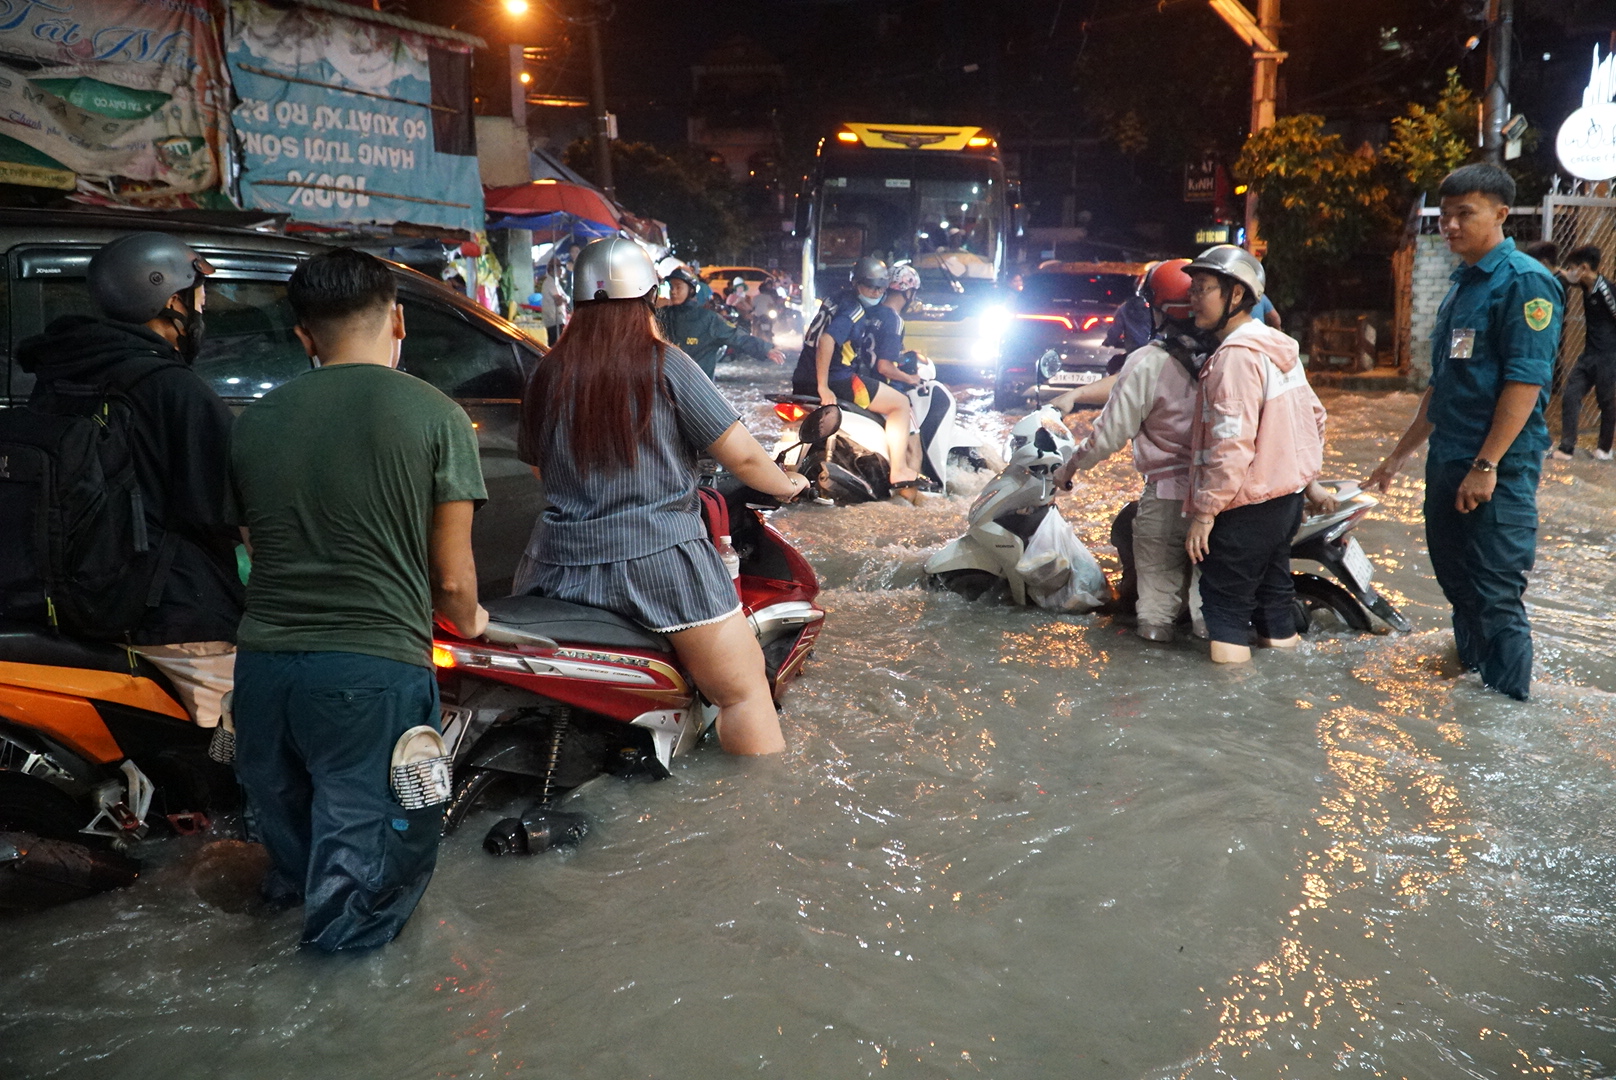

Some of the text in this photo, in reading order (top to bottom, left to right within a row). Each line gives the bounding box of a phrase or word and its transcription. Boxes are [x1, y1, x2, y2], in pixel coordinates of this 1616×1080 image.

[275, 101, 309, 129] RÕ
[313, 104, 343, 133] XỨ
[347, 109, 399, 139] XUẤT
[403, 118, 427, 144] CÓ
[304, 137, 354, 165] TƯƠI
[358, 143, 415, 174] HÀNG
[287, 170, 370, 209] 100%
